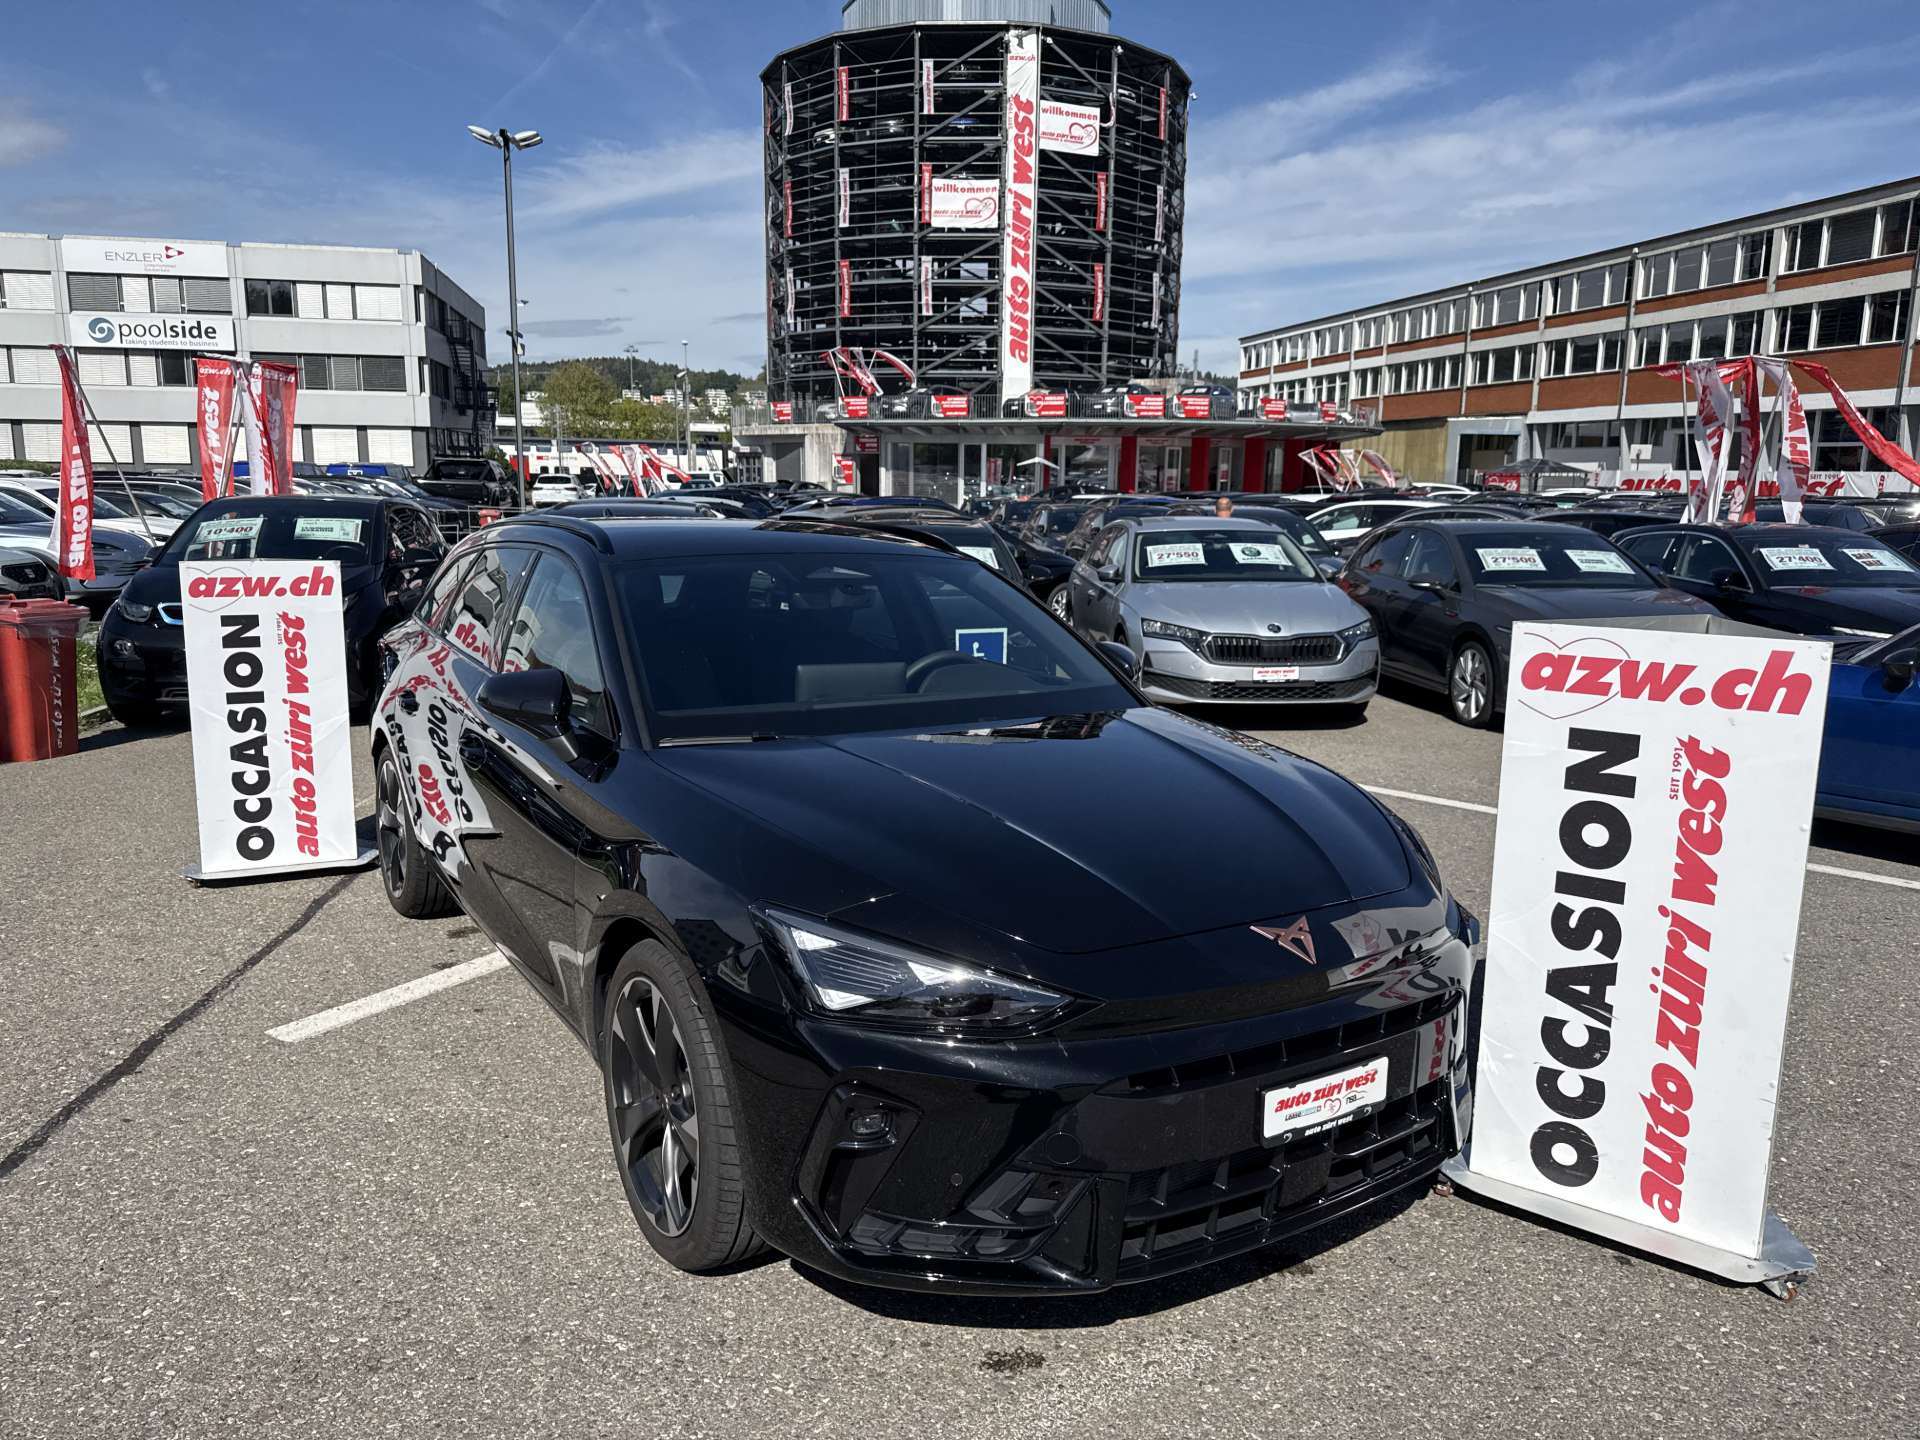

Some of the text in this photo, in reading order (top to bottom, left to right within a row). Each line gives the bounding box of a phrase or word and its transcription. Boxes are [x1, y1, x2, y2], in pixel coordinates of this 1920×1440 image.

[1041, 106, 1098, 120] willkommen
[934, 184, 997, 194] willkommen
[1007, 94, 1034, 363] auto züri west
[104, 251, 163, 263] ENZLER
[118, 319, 217, 344] poolside
[204, 386, 220, 447] west
[1620, 473, 1683, 492] auto
[205, 526, 254, 536] 10'400
[1157, 551, 1199, 560] 27'550
[1776, 556, 1823, 564] 27'400
[188, 566, 335, 599] azw.ch
[1521, 650, 1813, 715] azw.ch
[220, 613, 275, 861] OCCASION
[276, 611, 320, 858] auto züri west
[1669, 747, 1684, 800] SEIT 1991
[1530, 727, 1641, 1187] OCCASION
[1638, 735, 1731, 1223] auto züri west
[1274, 1092, 1311, 1113] auto
[1312, 1078, 1344, 1103] züri
[1345, 1071, 1378, 1091] west
[1305, 1125, 1322, 1136] auto
[1338, 1114, 1354, 1126] west
